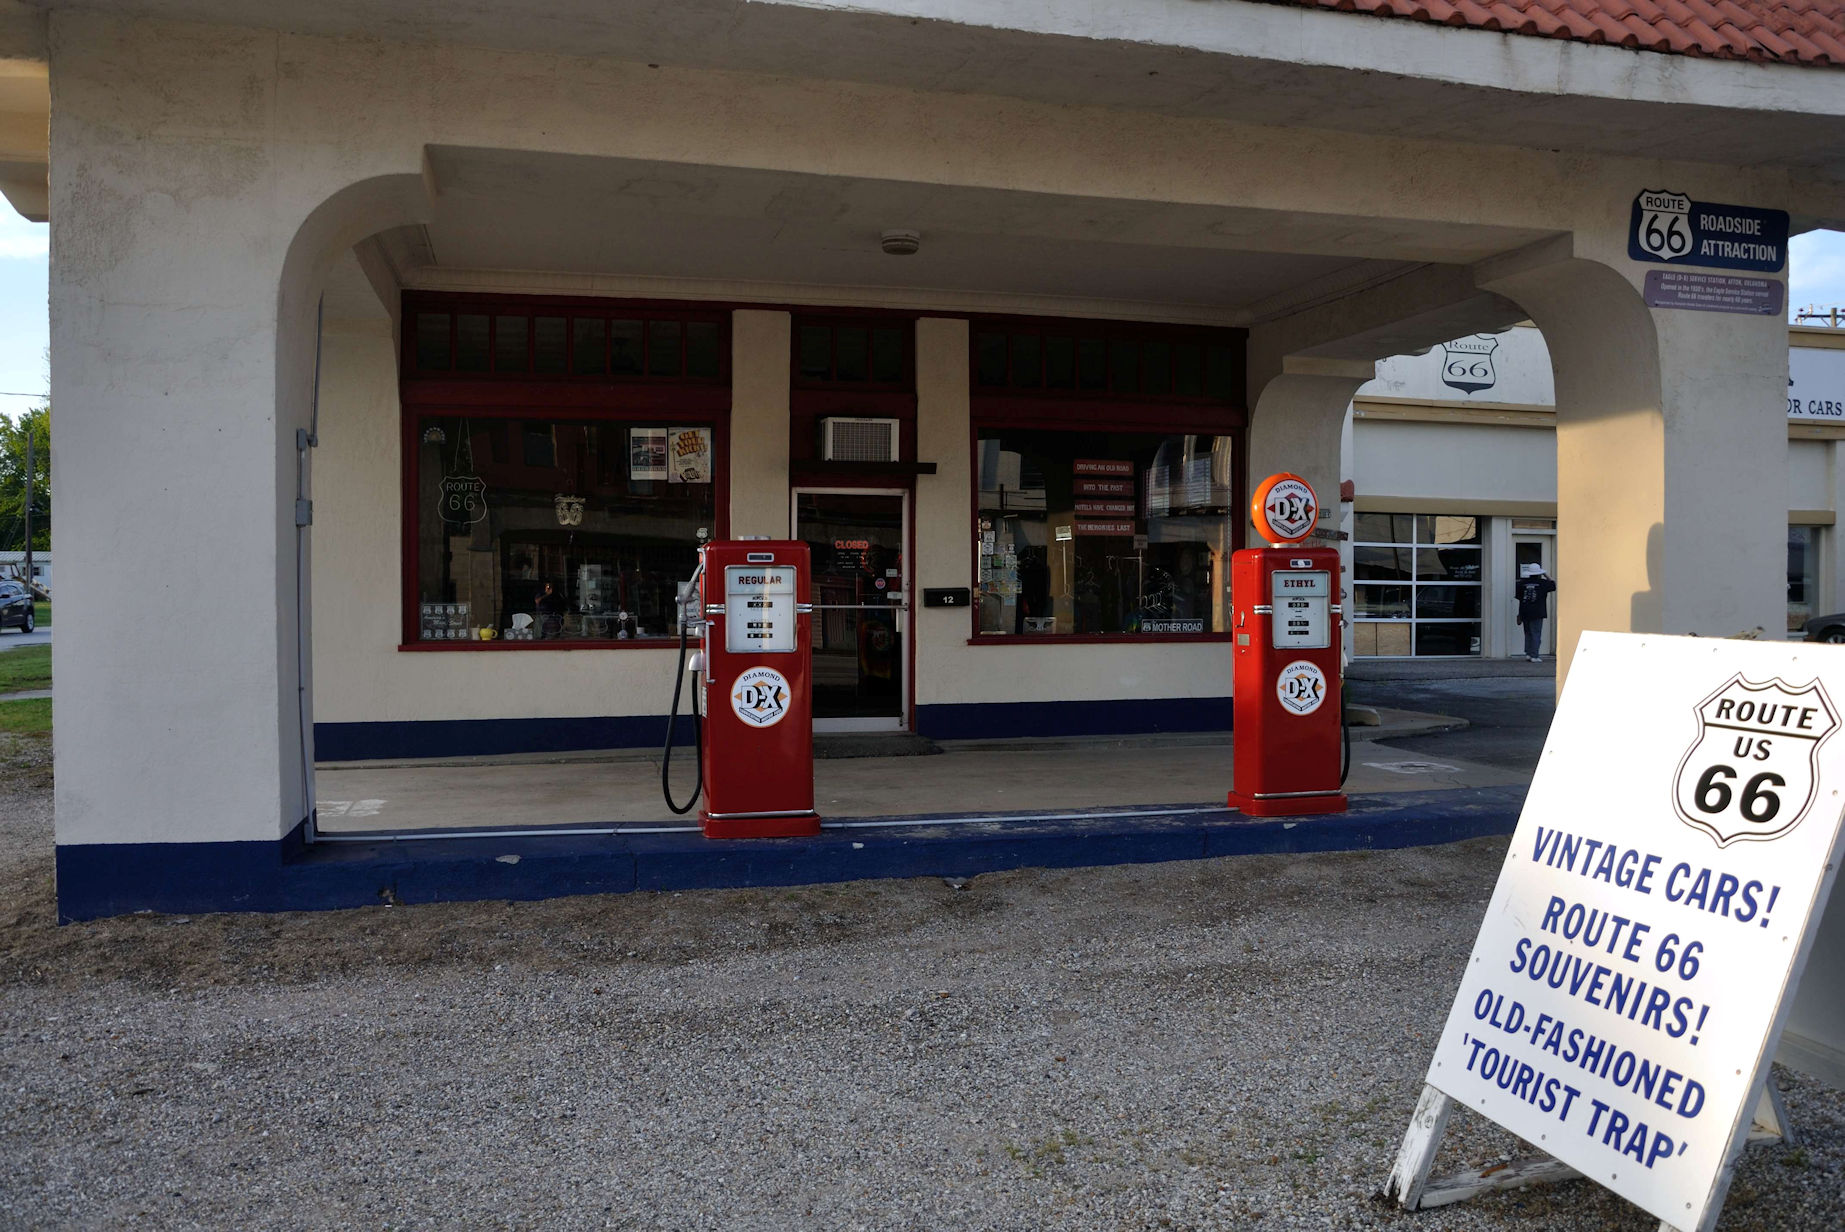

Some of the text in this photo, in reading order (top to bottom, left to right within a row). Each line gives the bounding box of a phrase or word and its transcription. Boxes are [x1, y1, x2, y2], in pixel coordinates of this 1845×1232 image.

[1646, 197, 1684, 210] ROUTE
[1700, 214, 1761, 235] ROADSIDE
[1646, 214, 1686, 253] 66
[1701, 240, 1777, 261] ATTRACTION
[1447, 360, 1488, 377] 66
[1808, 400, 1843, 416] CARS
[446, 482, 480, 491] ROUTE
[1275, 485, 1308, 494] DIAMOND
[449, 494, 475, 511] 66
[834, 540, 869, 549] CLOSED
[738, 576, 782, 585] REGULAR
[1283, 580, 1316, 588] ETHYL
[943, 596, 954, 604] 12
[1152, 622, 1181, 632] MOTHER
[1182, 622, 1202, 632] ROAD
[743, 672, 781, 682] DIAMOND
[1286, 665, 1318, 674] DIAMOND
[1715, 698, 1818, 730] ROUTE
[1733, 736, 1773, 761] US
[1694, 764, 1786, 823] 66
[1531, 826, 1781, 928] VINTAGE CARS!
[1540, 895, 1704, 981] ROUTE 66
[1509, 937, 1710, 1046] SOUVENIRS!
[1473, 988, 1706, 1119] OLD-FASHIONED
[1463, 1032, 1688, 1169] 'TOURIST TRAP'
